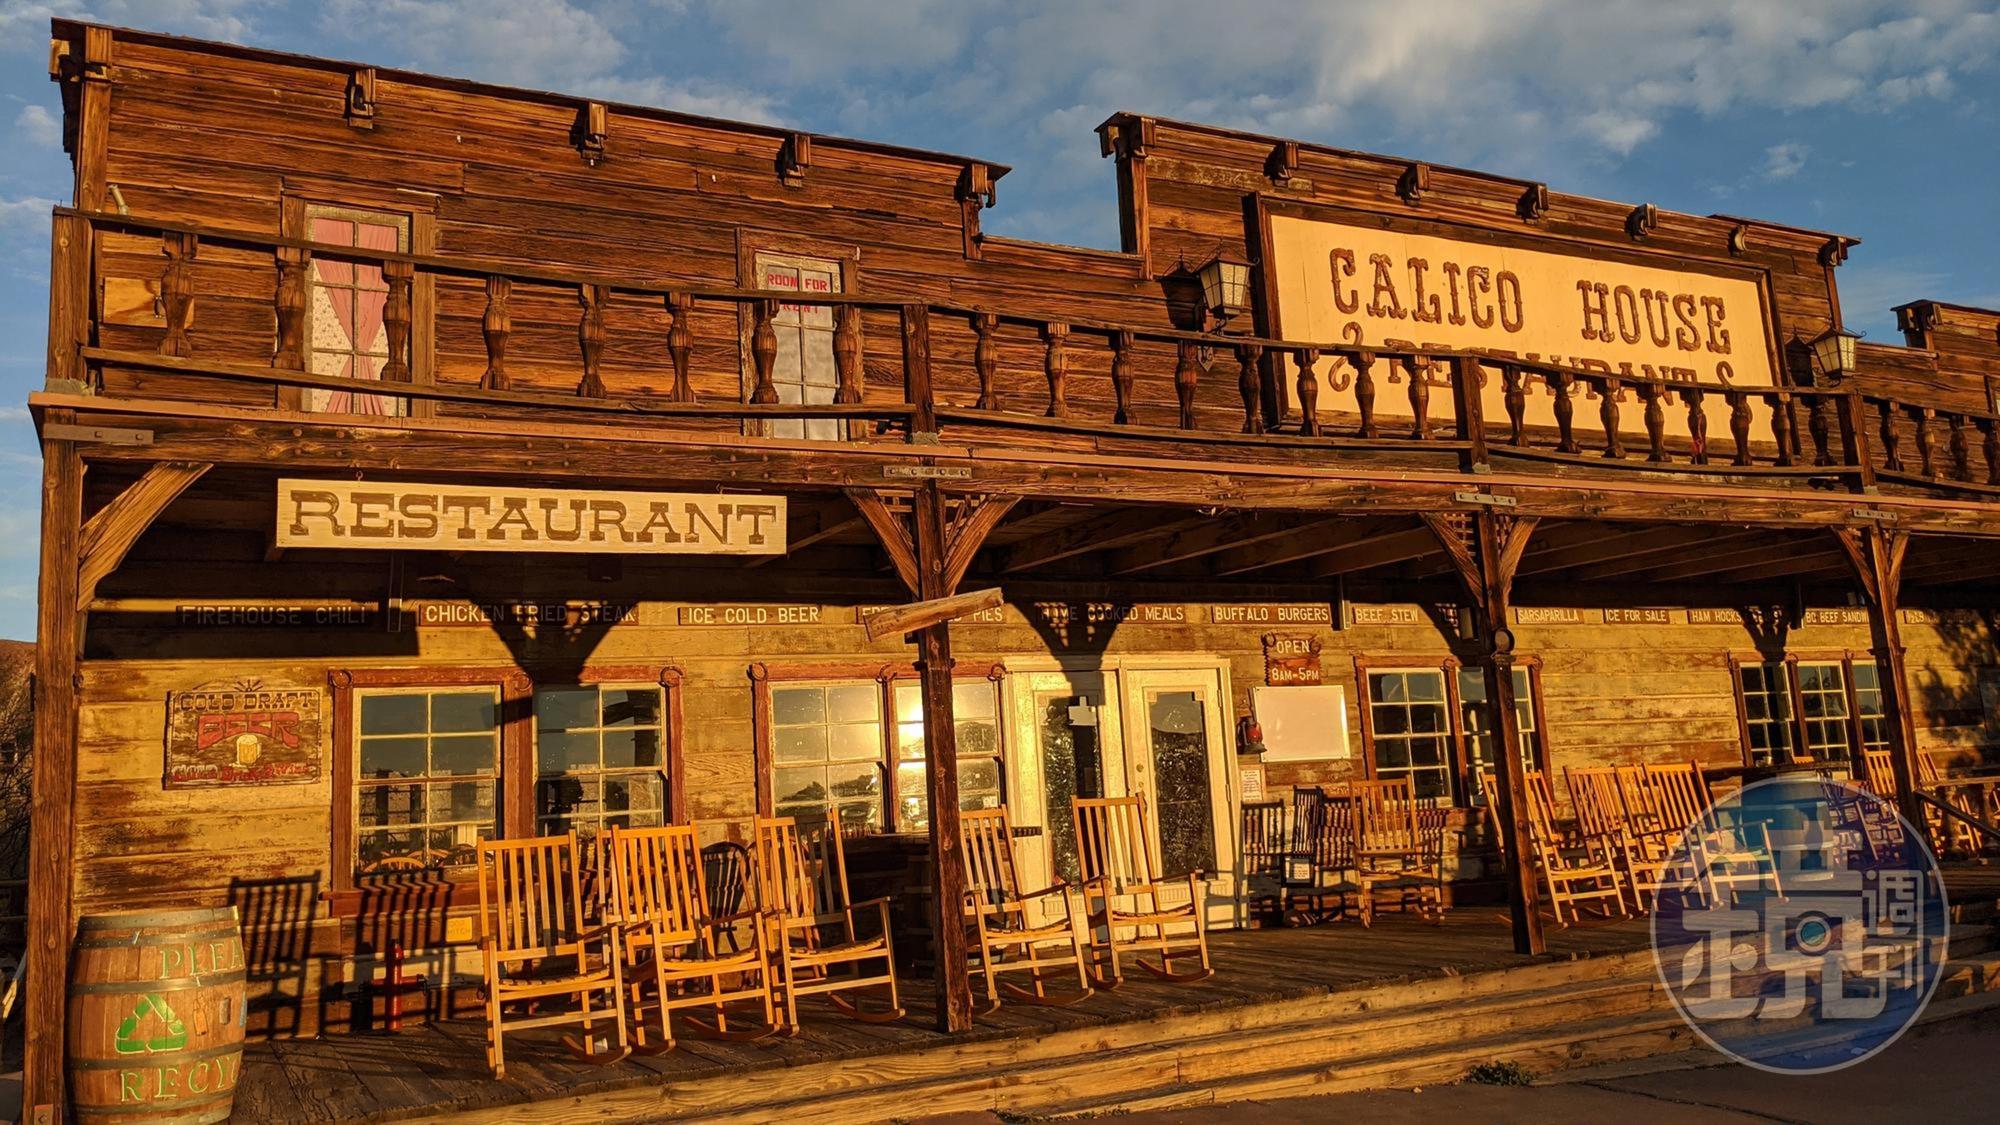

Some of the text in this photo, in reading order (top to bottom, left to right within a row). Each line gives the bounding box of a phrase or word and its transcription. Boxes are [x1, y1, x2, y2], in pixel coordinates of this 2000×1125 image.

[768, 273, 829, 291] ROOM FOR
[1329, 247, 1731, 355] CALICO HOUSE
[289, 489, 777, 545] RESTAURANT
[182, 606, 365, 625] FIREHOUSE CHILI
[425, 604, 637, 622] CHICKEN FRIED STEAK
[688, 606, 819, 623] ICE COLD BEER
[1041, 606, 1184, 621] HOME COOKED MEALS
[1215, 606, 1329, 621] BUFFALO BURGERS
[1355, 608, 1418, 622] BEEF STEW
[1517, 609, 1580, 622] SARSAPARILLA
[1606, 609, 1667, 622] ICE FOR SALE
[1692, 610, 1742, 622] HAM HOCKS
[1820, 612, 1839, 623] BEEF
[1276, 639, 1310, 653] OPEN
[1272, 667, 1319, 681] 8AM-5PM
[180, 692, 312, 711] COLD DRAFT
[197, 711, 300, 751] BEER
